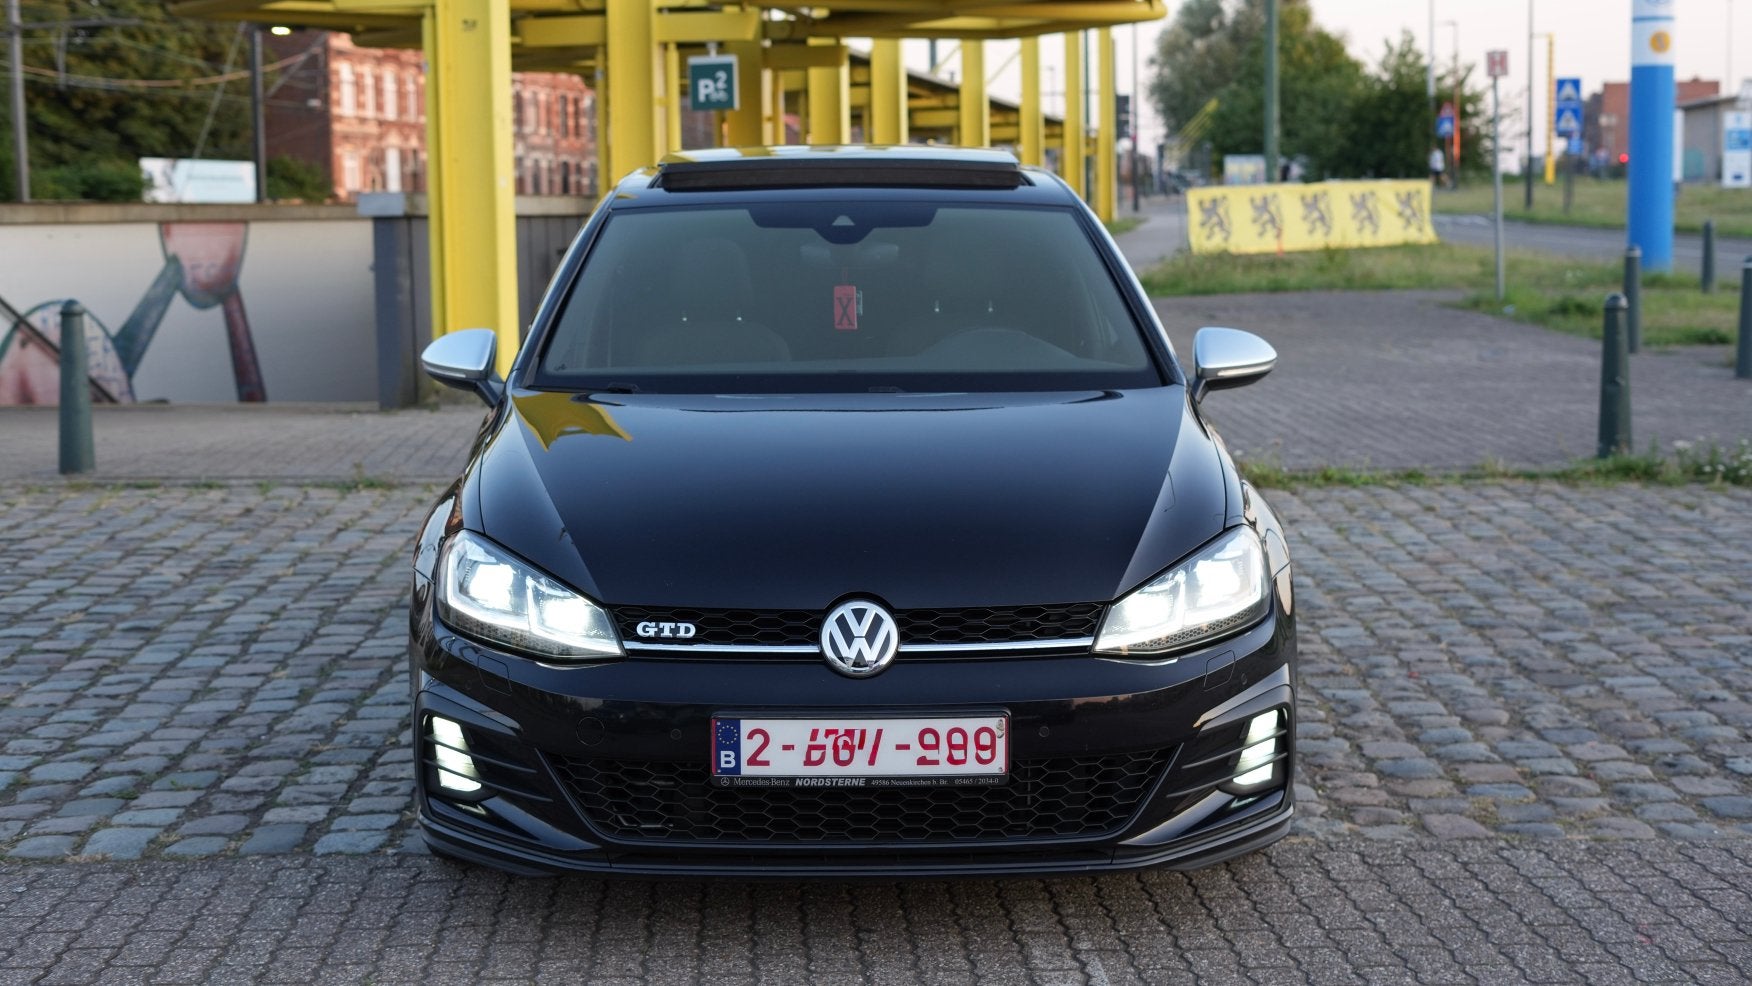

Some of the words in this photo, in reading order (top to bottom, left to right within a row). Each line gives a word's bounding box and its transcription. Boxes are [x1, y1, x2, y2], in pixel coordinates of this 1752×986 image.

[636, 622, 697, 638] GTD
[720, 751, 735, 768] B
[733, 778, 790, 786] Mercedes-Benz
[795, 778, 866, 786] NORDSTERNE
